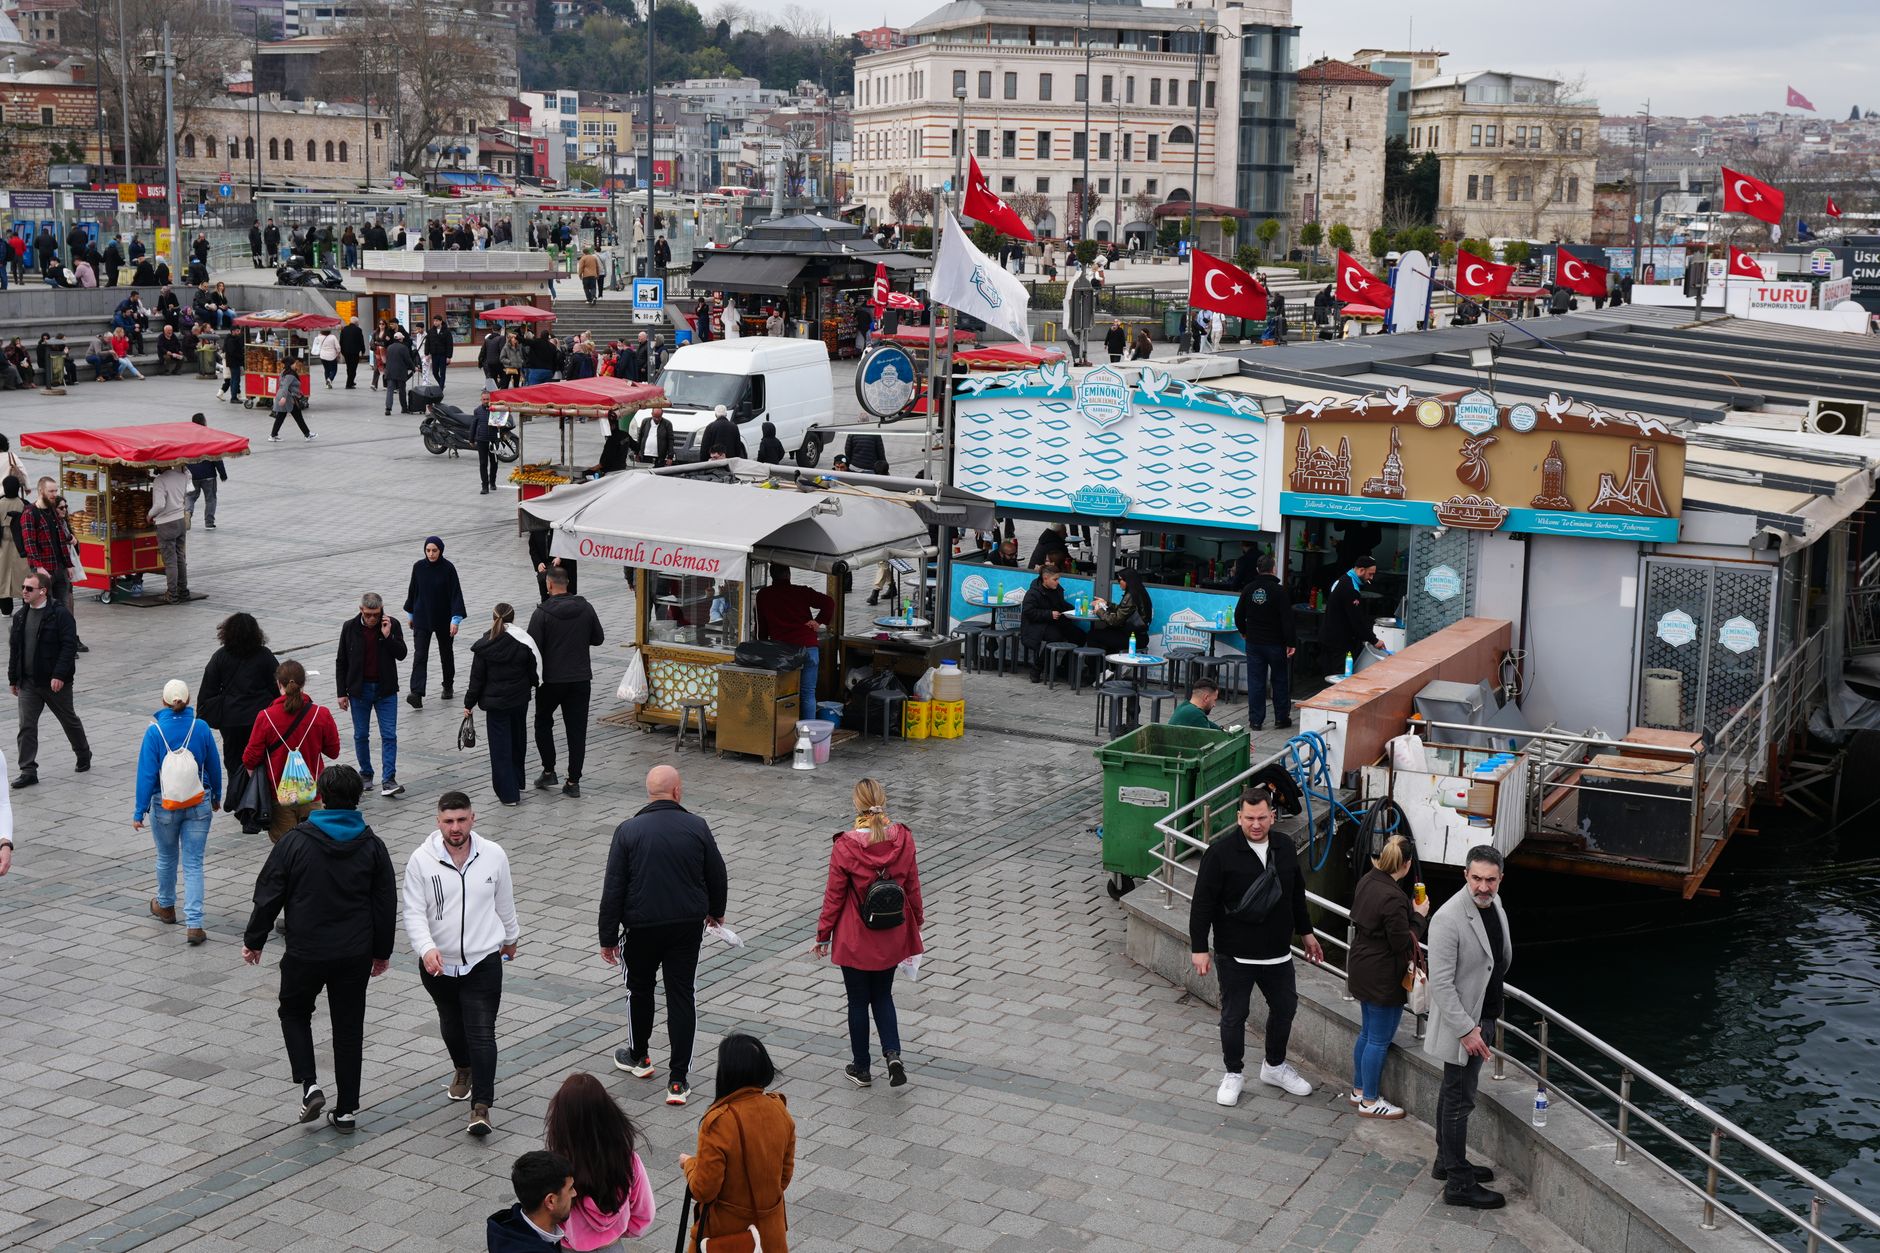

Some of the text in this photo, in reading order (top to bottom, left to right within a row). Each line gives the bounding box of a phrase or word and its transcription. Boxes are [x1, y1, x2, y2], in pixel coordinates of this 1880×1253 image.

[1757, 288, 1808, 303] TURU
[1085, 384, 1123, 399] EMİNÖNÜ
[1460, 405, 1493, 416] EMİNÖNÜ
[1535, 517, 1560, 526] Welcome
[579, 538, 720, 573] Osmanlı Lokması
